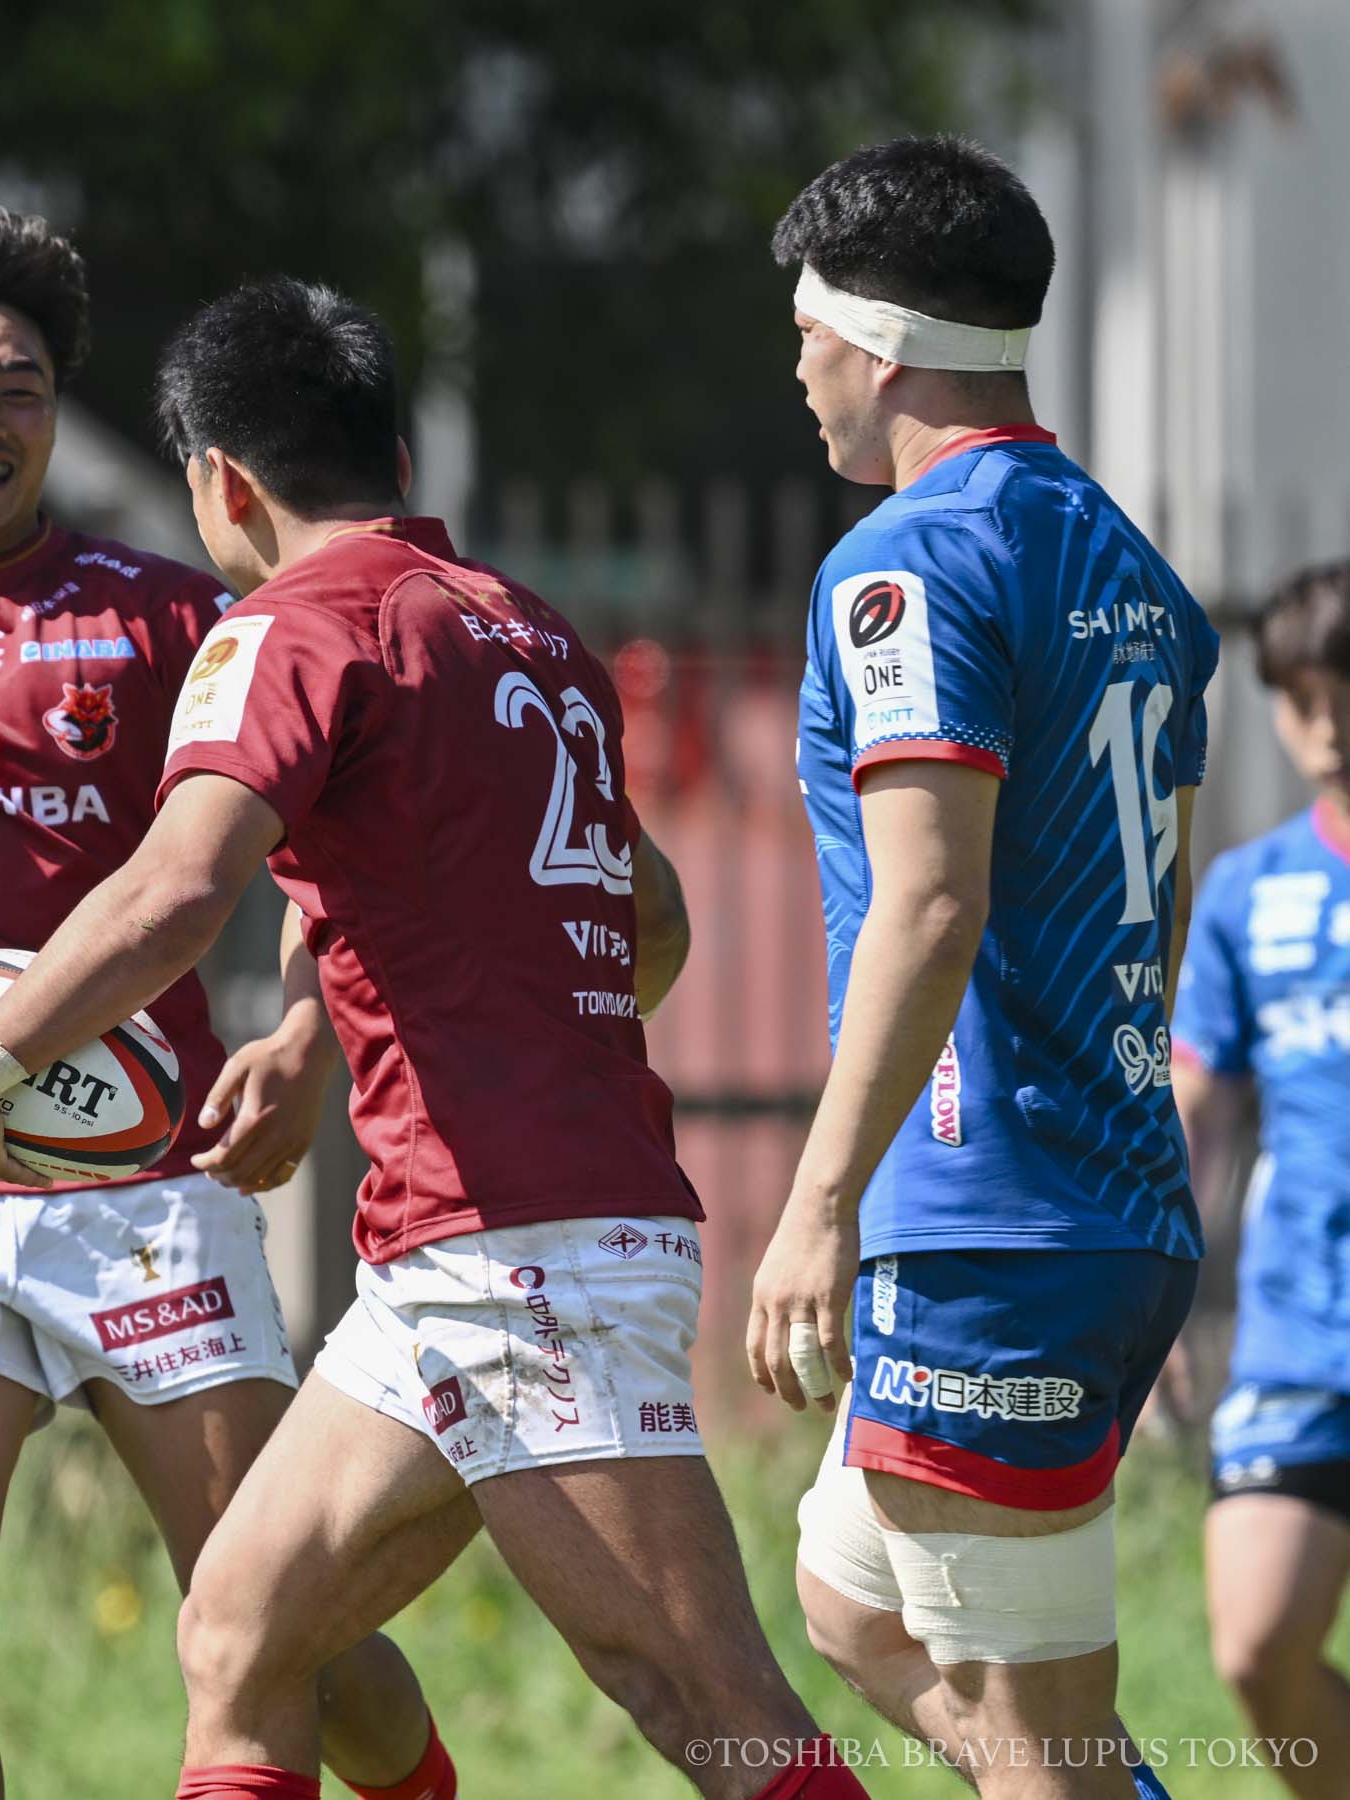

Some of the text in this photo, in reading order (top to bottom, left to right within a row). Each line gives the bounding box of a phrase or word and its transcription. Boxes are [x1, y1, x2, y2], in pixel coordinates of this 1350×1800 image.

[42, 635, 136, 661] INABA
[864, 664, 904, 696] ONE
[879, 707, 914, 724] NTT
[81, 1117, 95, 1127] psi
[103, 1289, 223, 1341] MS&AD
[113, 1333, 247, 1383] 三井住友海上
[936, 1373, 1081, 1418] 日本建設
[638, 1401, 698, 1434] 能美
